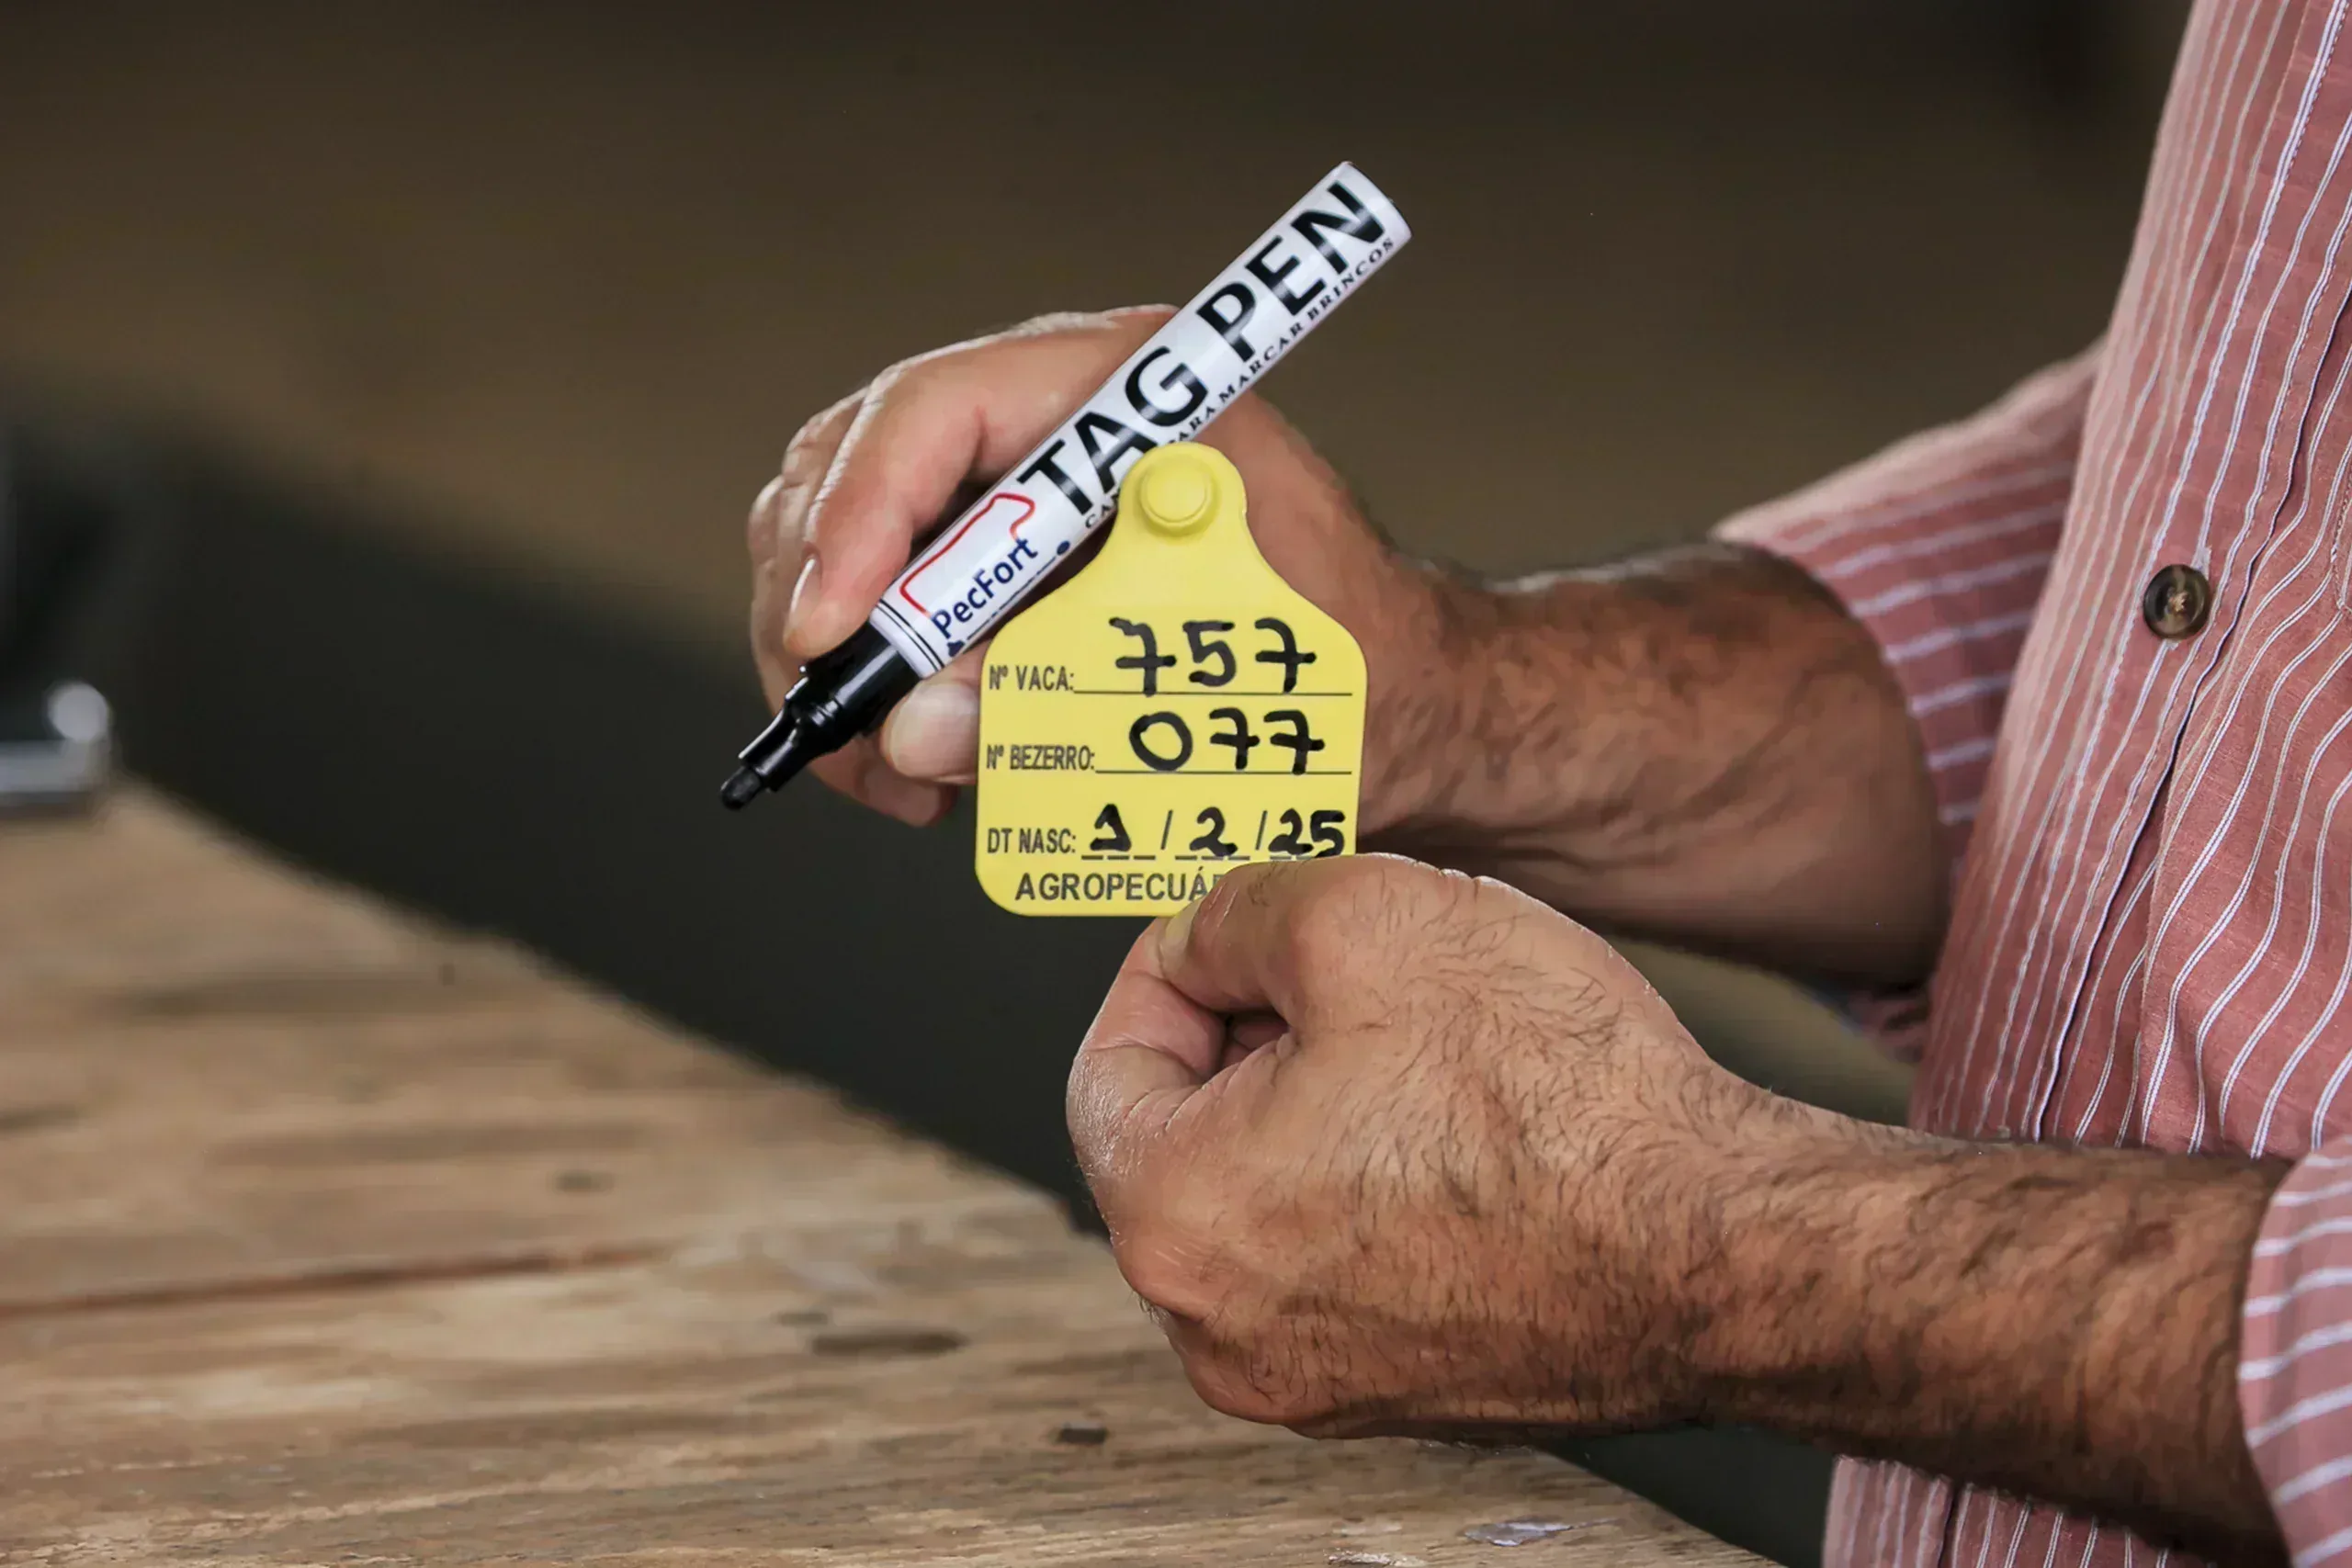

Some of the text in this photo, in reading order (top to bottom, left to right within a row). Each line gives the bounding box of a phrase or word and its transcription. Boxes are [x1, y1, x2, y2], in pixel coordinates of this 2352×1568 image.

[1017, 181, 1385, 515] TAG PEN
[1168, 405, 1216, 444] ARA
[1219, 322, 1304, 402] MARCAR
[1307, 237, 1395, 321] BRINCOS
[931, 537, 1039, 639] PecFort
[1015, 664, 1074, 691] VACA:
[1109, 616, 1317, 696] 757
[1010, 744, 1095, 771] BEZERRO:
[1128, 707, 1326, 774] 077
[987, 828, 1012, 853] DT
[1019, 828, 1077, 853] NASC:
